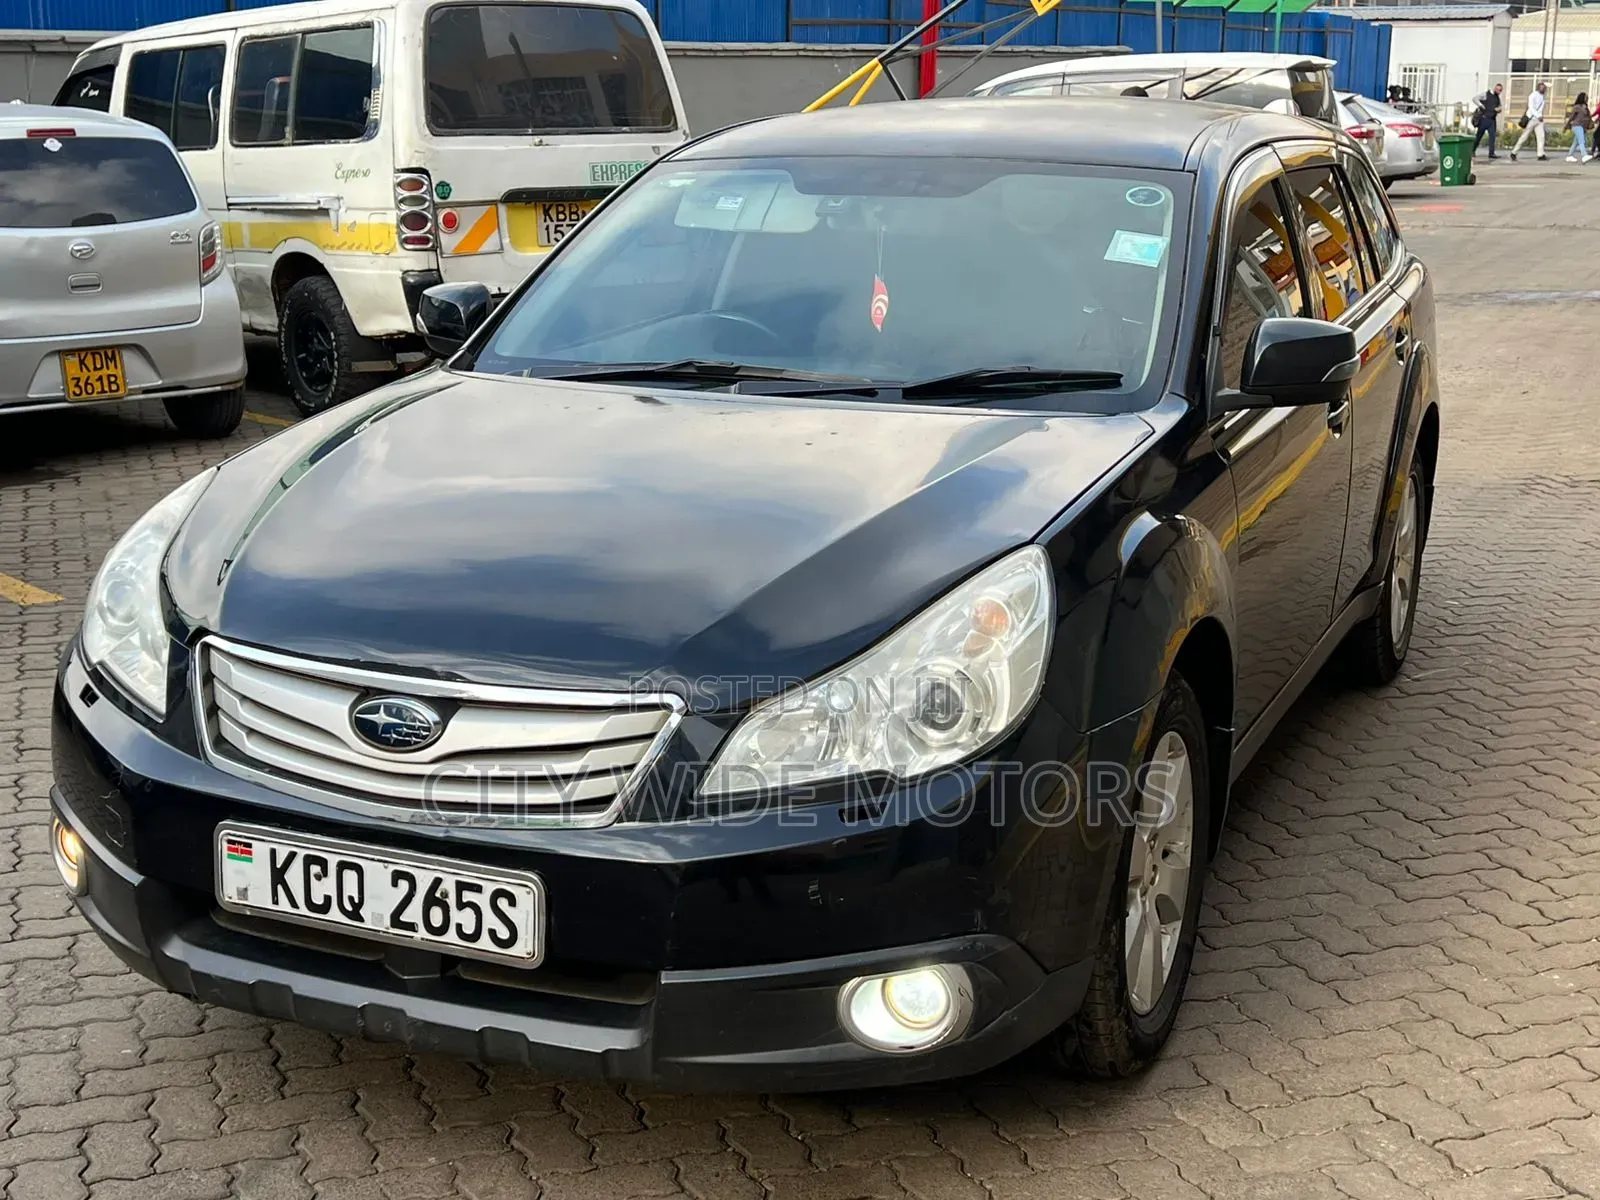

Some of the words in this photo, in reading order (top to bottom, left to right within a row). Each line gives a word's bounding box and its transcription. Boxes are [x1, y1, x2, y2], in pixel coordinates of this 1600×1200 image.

[78, 350, 118, 373] KDM
[71, 374, 120, 397] 361B
[269, 847, 366, 923] KCQ
[389, 869, 519, 950] 265S
